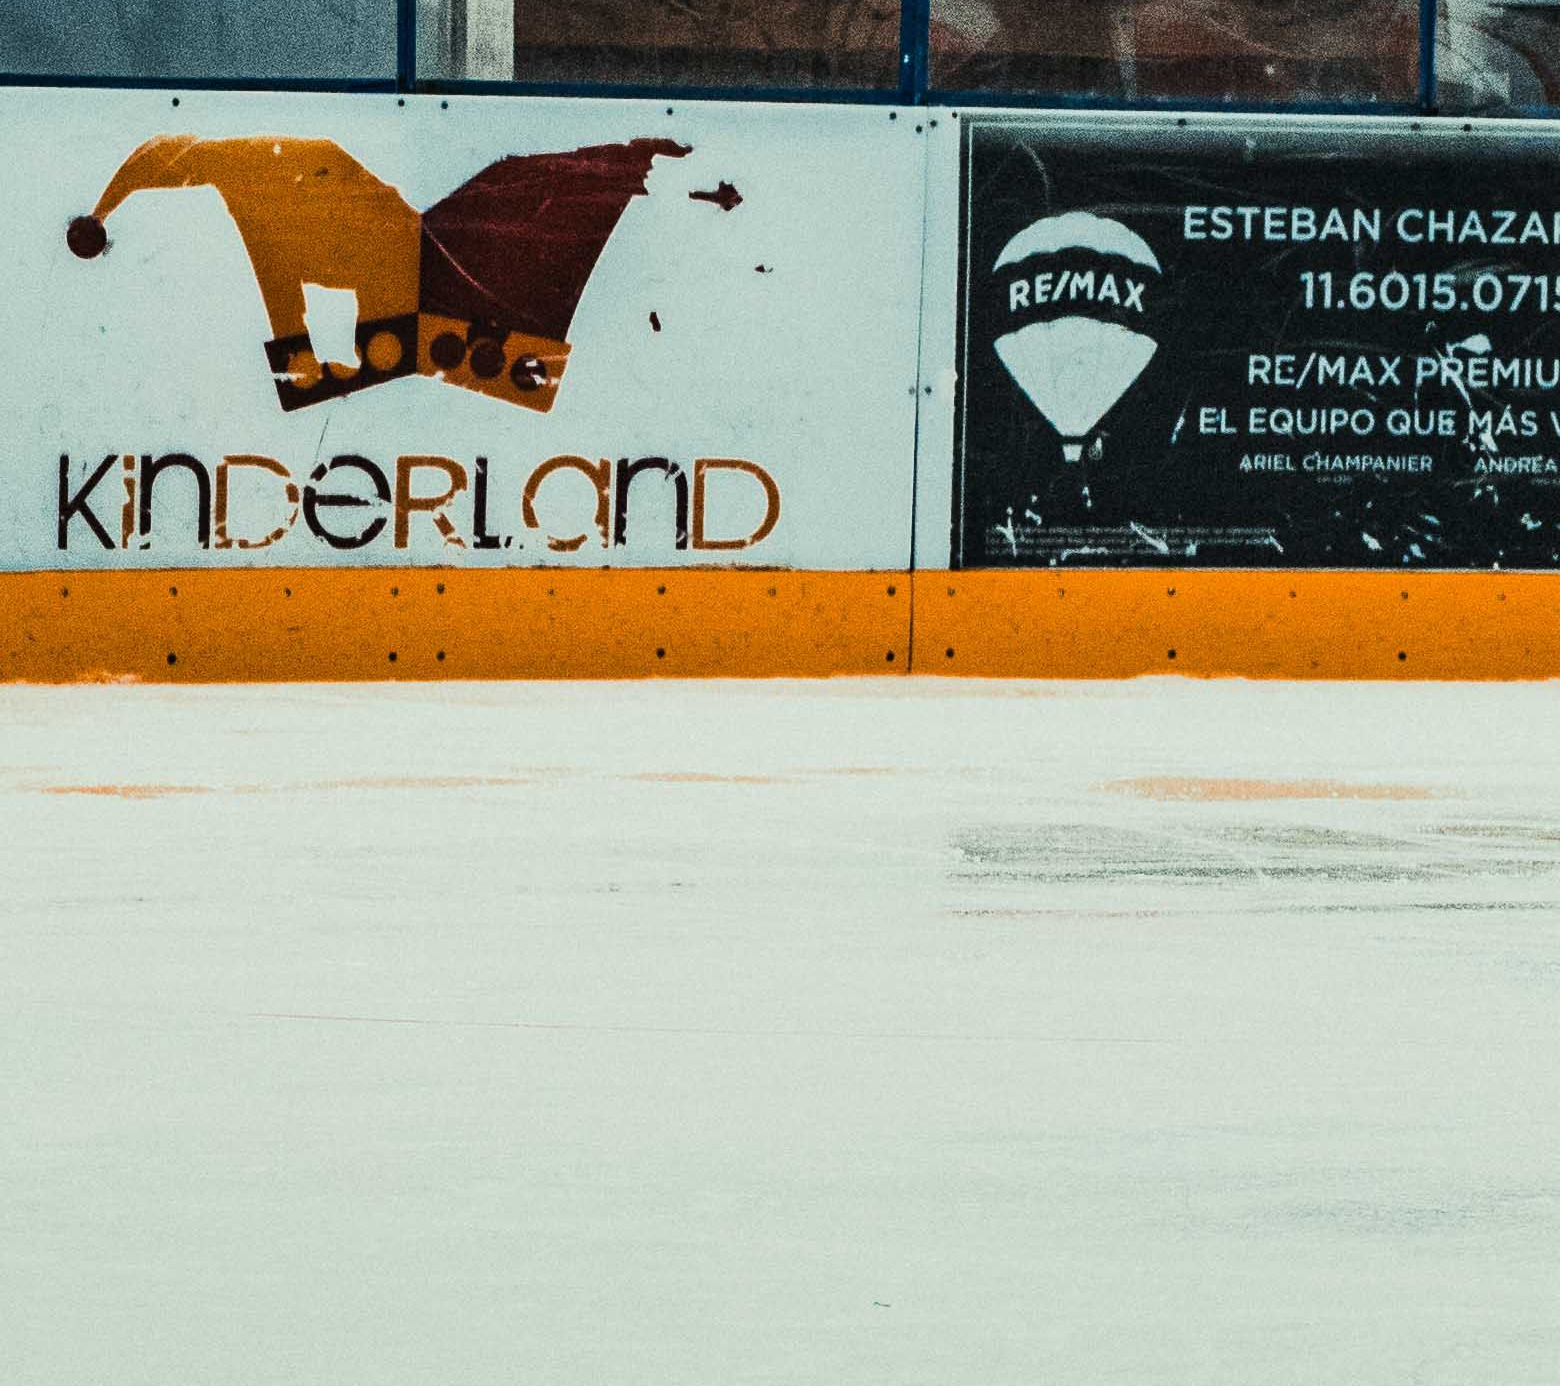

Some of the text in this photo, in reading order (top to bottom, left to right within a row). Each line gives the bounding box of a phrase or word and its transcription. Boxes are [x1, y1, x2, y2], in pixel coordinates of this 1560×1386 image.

[1183, 206, 1381, 241] ESTEBAN
[1010, 270, 1144, 312] RE/MAX
[1247, 352, 1401, 390] RE/MAX
[1199, 407, 1237, 433] EL
[1248, 407, 1375, 437] EQUIPO
[1386, 409, 1457, 437] QUE
[1468, 405, 1538, 437] MÁS
[1238, 453, 1434, 473] ARIEL CHAMPANIER
